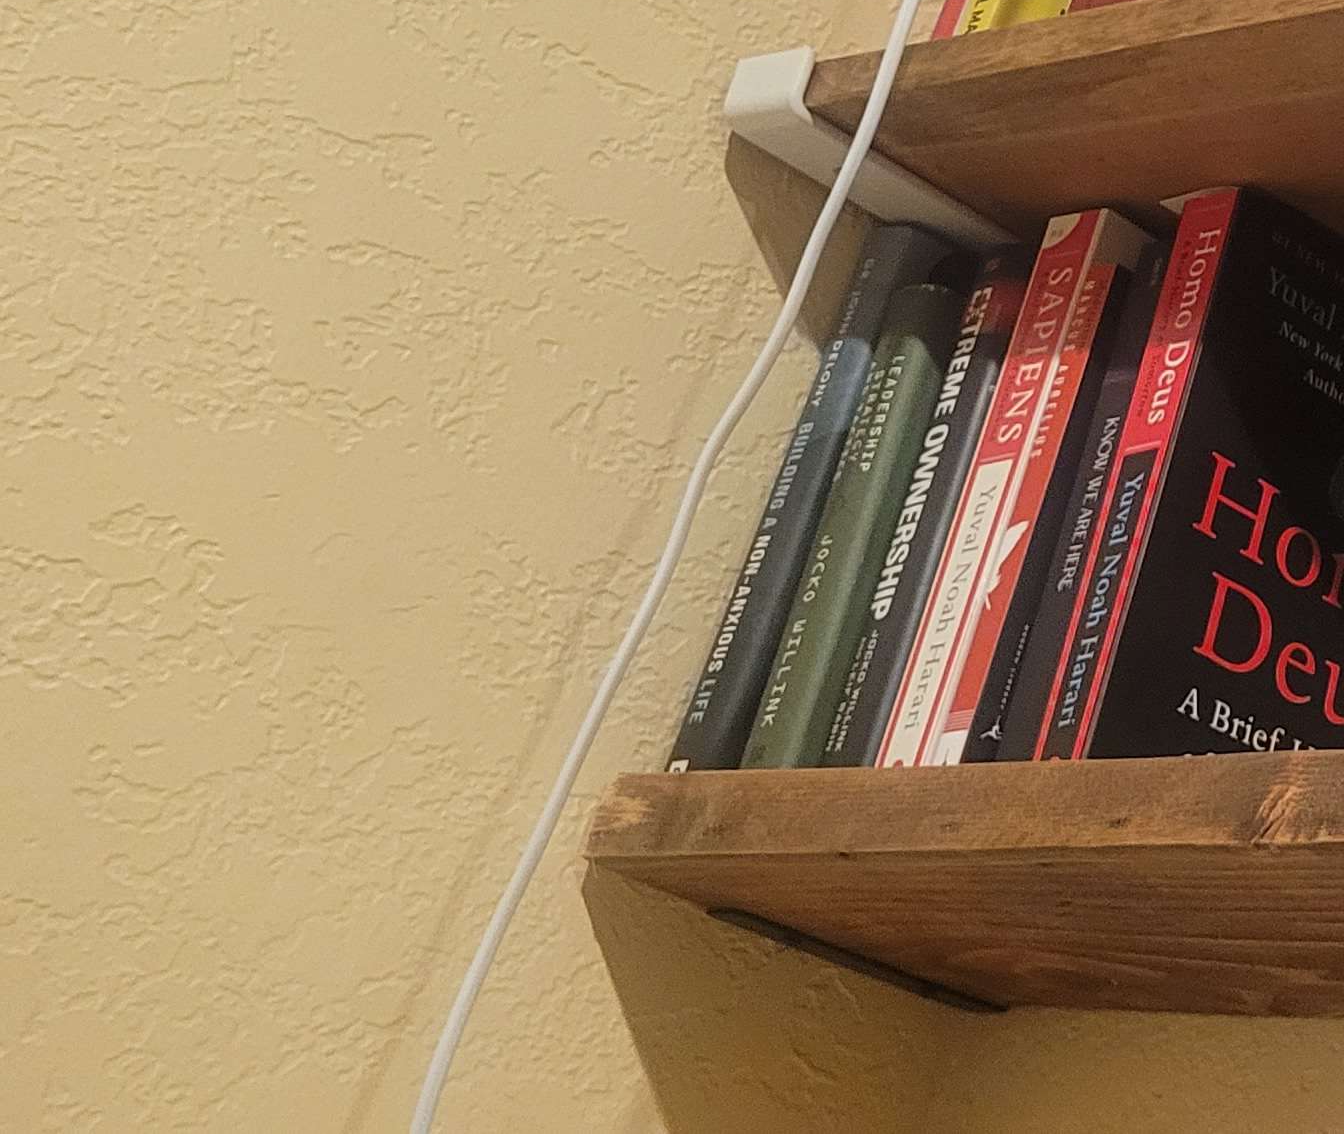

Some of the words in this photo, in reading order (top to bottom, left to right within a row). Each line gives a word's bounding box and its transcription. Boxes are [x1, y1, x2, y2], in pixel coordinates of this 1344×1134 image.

[1175, 227, 1221, 331] Homo
[933, 286, 994, 417] EXTREME
[996, 267, 1073, 445] SAPIENS
[1147, 337, 1191, 427] Deus
[860, 355, 907, 474] LEADERSHIP
[1092, 415, 1121, 470] KNOW
[768, 420, 815, 515] BUILDING
[1082, 475, 1104, 506] WE
[1110, 471, 1145, 547] Yuval
[871, 421, 951, 623] OWNERSHIP
[959, 485, 997, 556] Yuval
[1071, 507, 1094, 544] ARE
[708, 533, 770, 674] NON-ANXIOUS
[801, 533, 834, 604] JOCKO
[934, 560, 973, 639] Noah
[1057, 544, 1081, 593] HERE
[1083, 553, 1122, 635] Noah
[688, 674, 717, 725] LIFE
[760, 619, 808, 730] WILLINK
[903, 637, 948, 731] Harari
[1058, 633, 1096, 731] Harari
[1178, 688, 1203, 721] A
[1212, 703, 1287, 755] Brief
